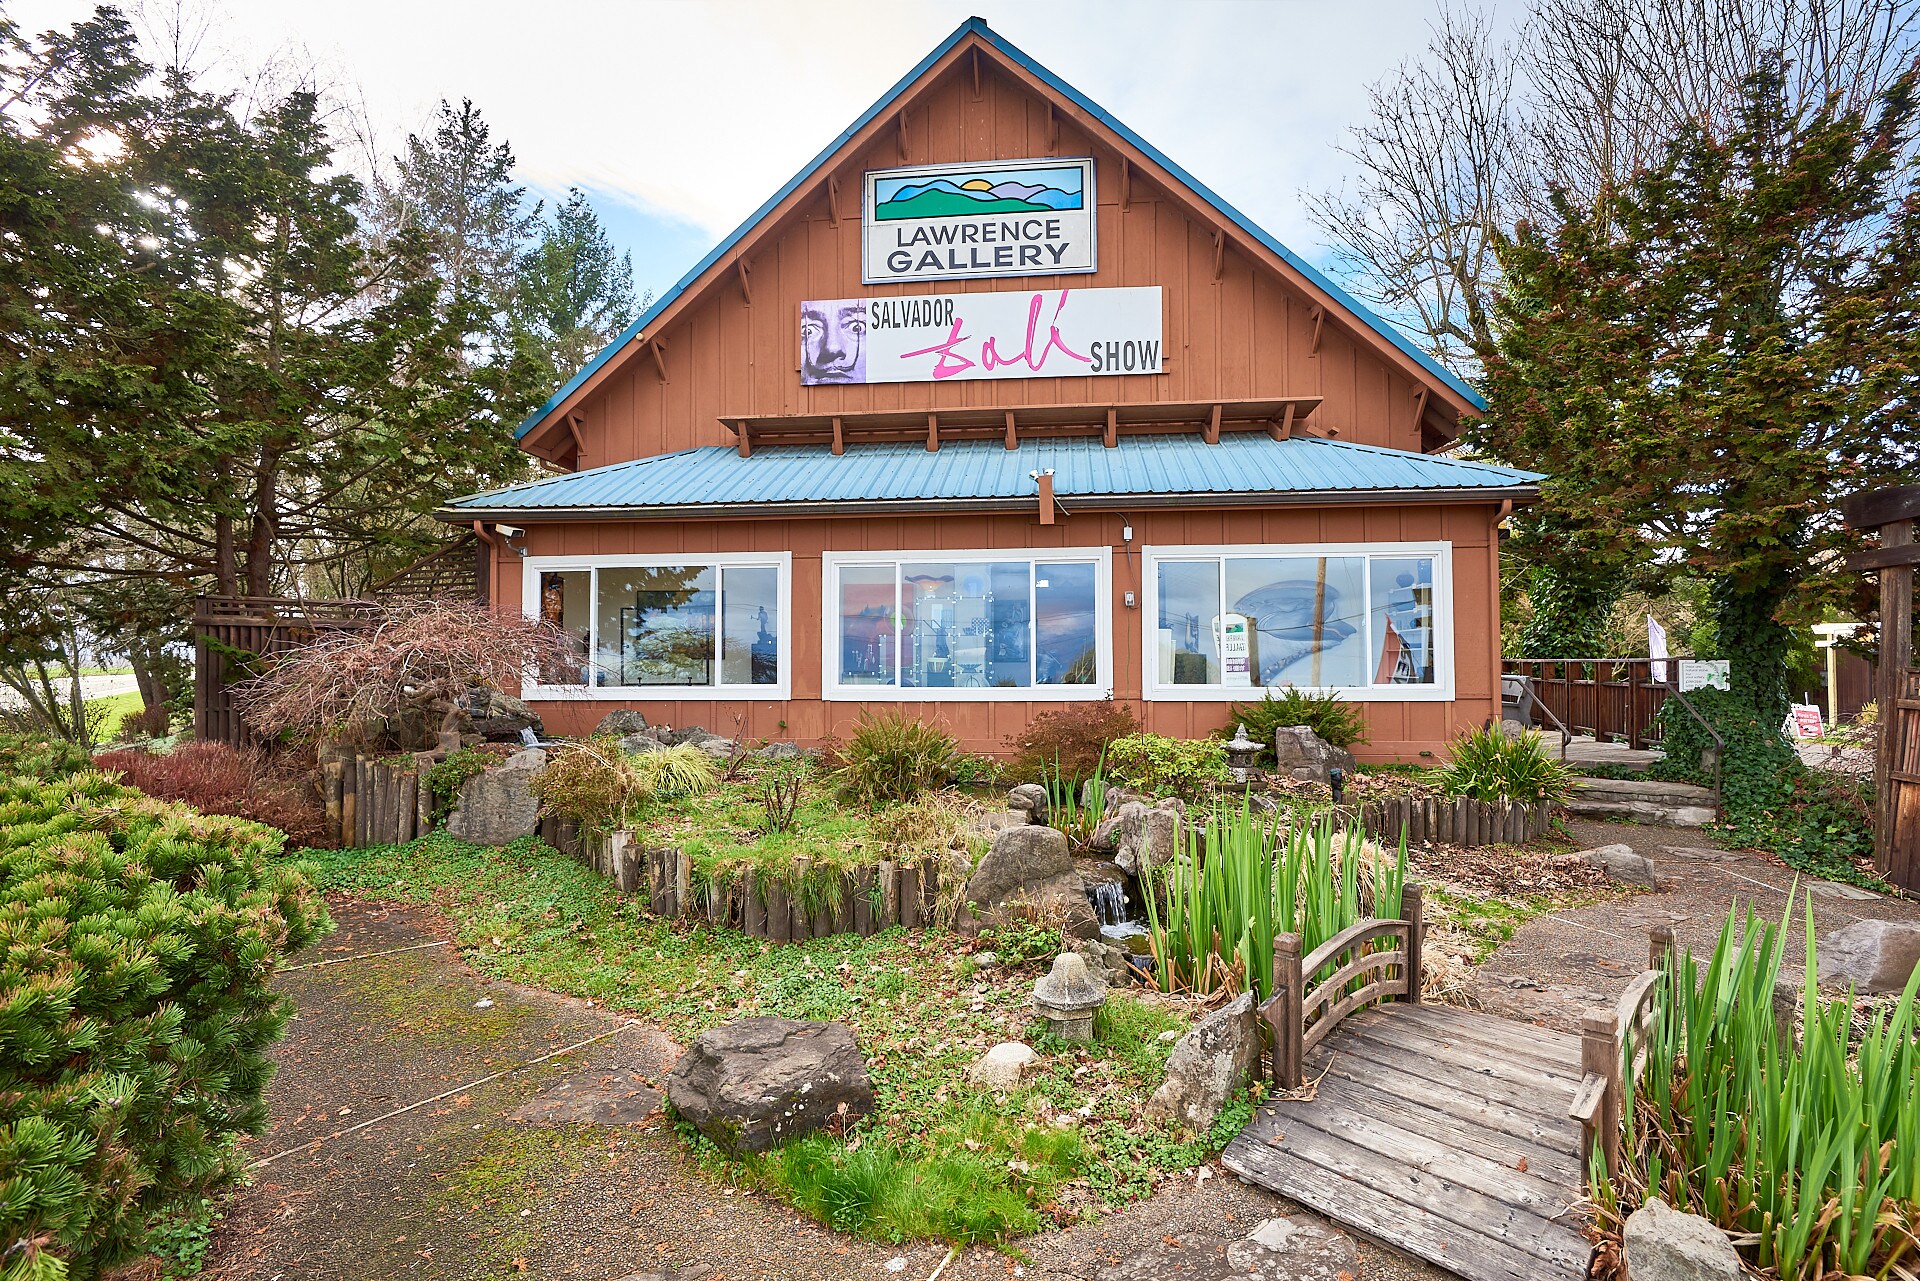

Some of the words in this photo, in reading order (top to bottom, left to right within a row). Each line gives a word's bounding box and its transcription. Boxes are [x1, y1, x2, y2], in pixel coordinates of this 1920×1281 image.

[897, 219, 1061, 247] LAWRENCE
[887, 243, 1070, 273] GALLERY
[871, 299, 954, 329] SALVADOR
[1091, 340, 1159, 372] SHOW
